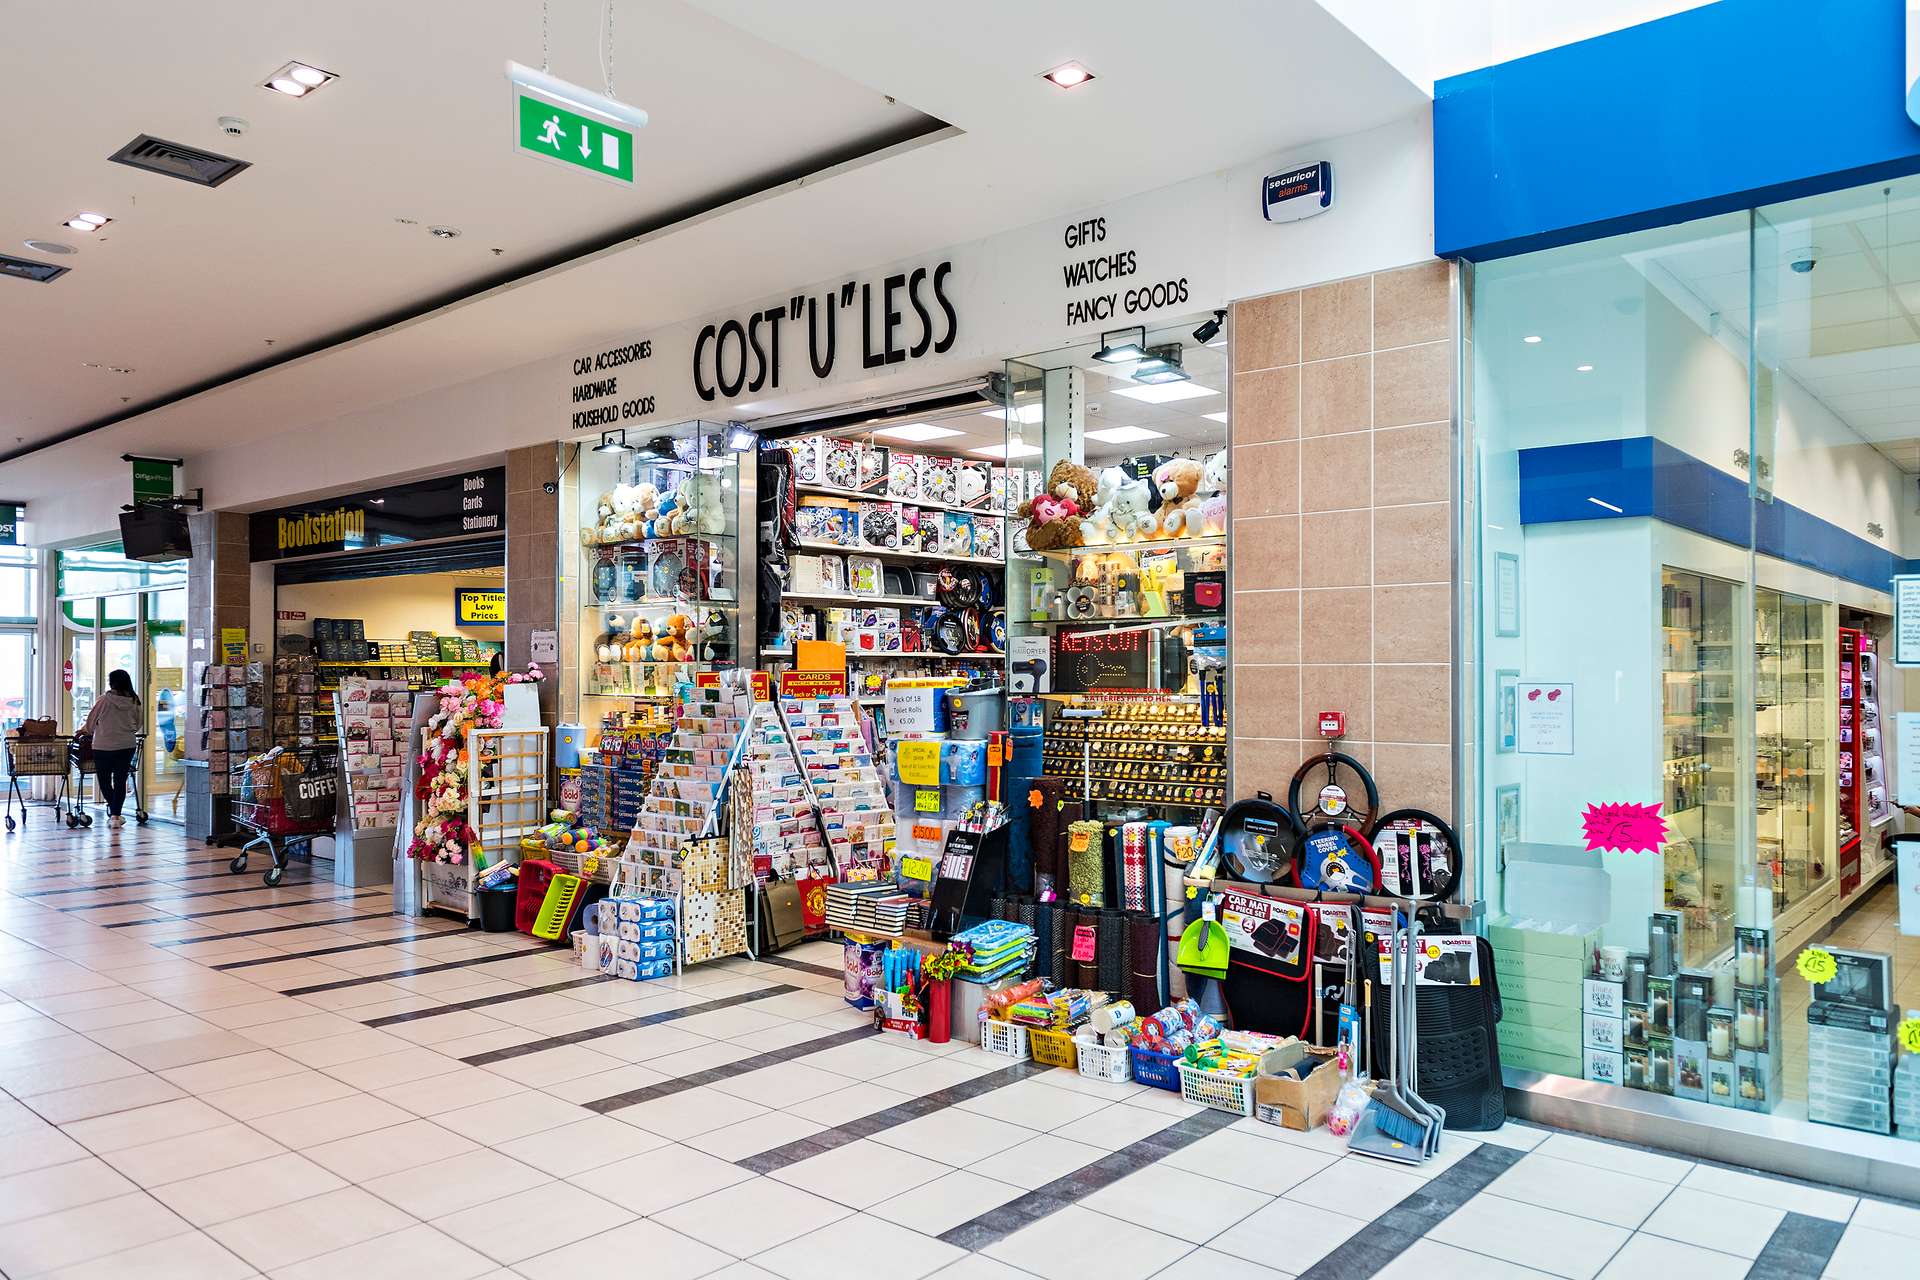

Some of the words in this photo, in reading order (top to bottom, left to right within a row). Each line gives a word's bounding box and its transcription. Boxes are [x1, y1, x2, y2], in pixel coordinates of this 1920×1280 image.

[1269, 170, 1316, 188] securicor
[1279, 183, 1308, 197] alarms
[1064, 217, 1106, 249] GIFTS
[1063, 250, 1137, 288] WATCHES
[1067, 293, 1117, 326] FANCY
[1124, 277, 1189, 314] GOODS
[573, 356, 592, 376] CAR
[594, 339, 652, 371] ACCESSORIES
[572, 377, 617, 403] HARDWARE
[572, 405, 619, 430] HOUSEHOLD
[622, 396, 655, 419] GOODS
[463, 475, 484, 492] Books
[463, 495, 483, 511] Cards
[277, 507, 365, 550] Bookstation
[463, 513, 498, 530] Stationery
[462, 594, 479, 603] Top
[481, 593, 505, 602] Titles
[470, 611, 498, 619] Prices
[475, 603, 494, 611] Low
[1106, 630, 1143, 651] CUT
[811, 688, 817, 697] 3
[629, 741, 641, 750] Sun
[642, 738, 654, 748] Sun
[299, 777, 338, 799] COFFE
[563, 788, 578, 800] Bold
[1311, 835, 1338, 846] STEERING
[1316, 841, 1336, 849] WHEEL
[1228, 895, 1247, 907] CAR
[1248, 900, 1269, 912] MAT
[1236, 906, 1254, 915] PIECE
[1254, 910, 1267, 919] SET
[1243, 921, 1253, 930] 4
[866, 968, 882, 976] Bold
